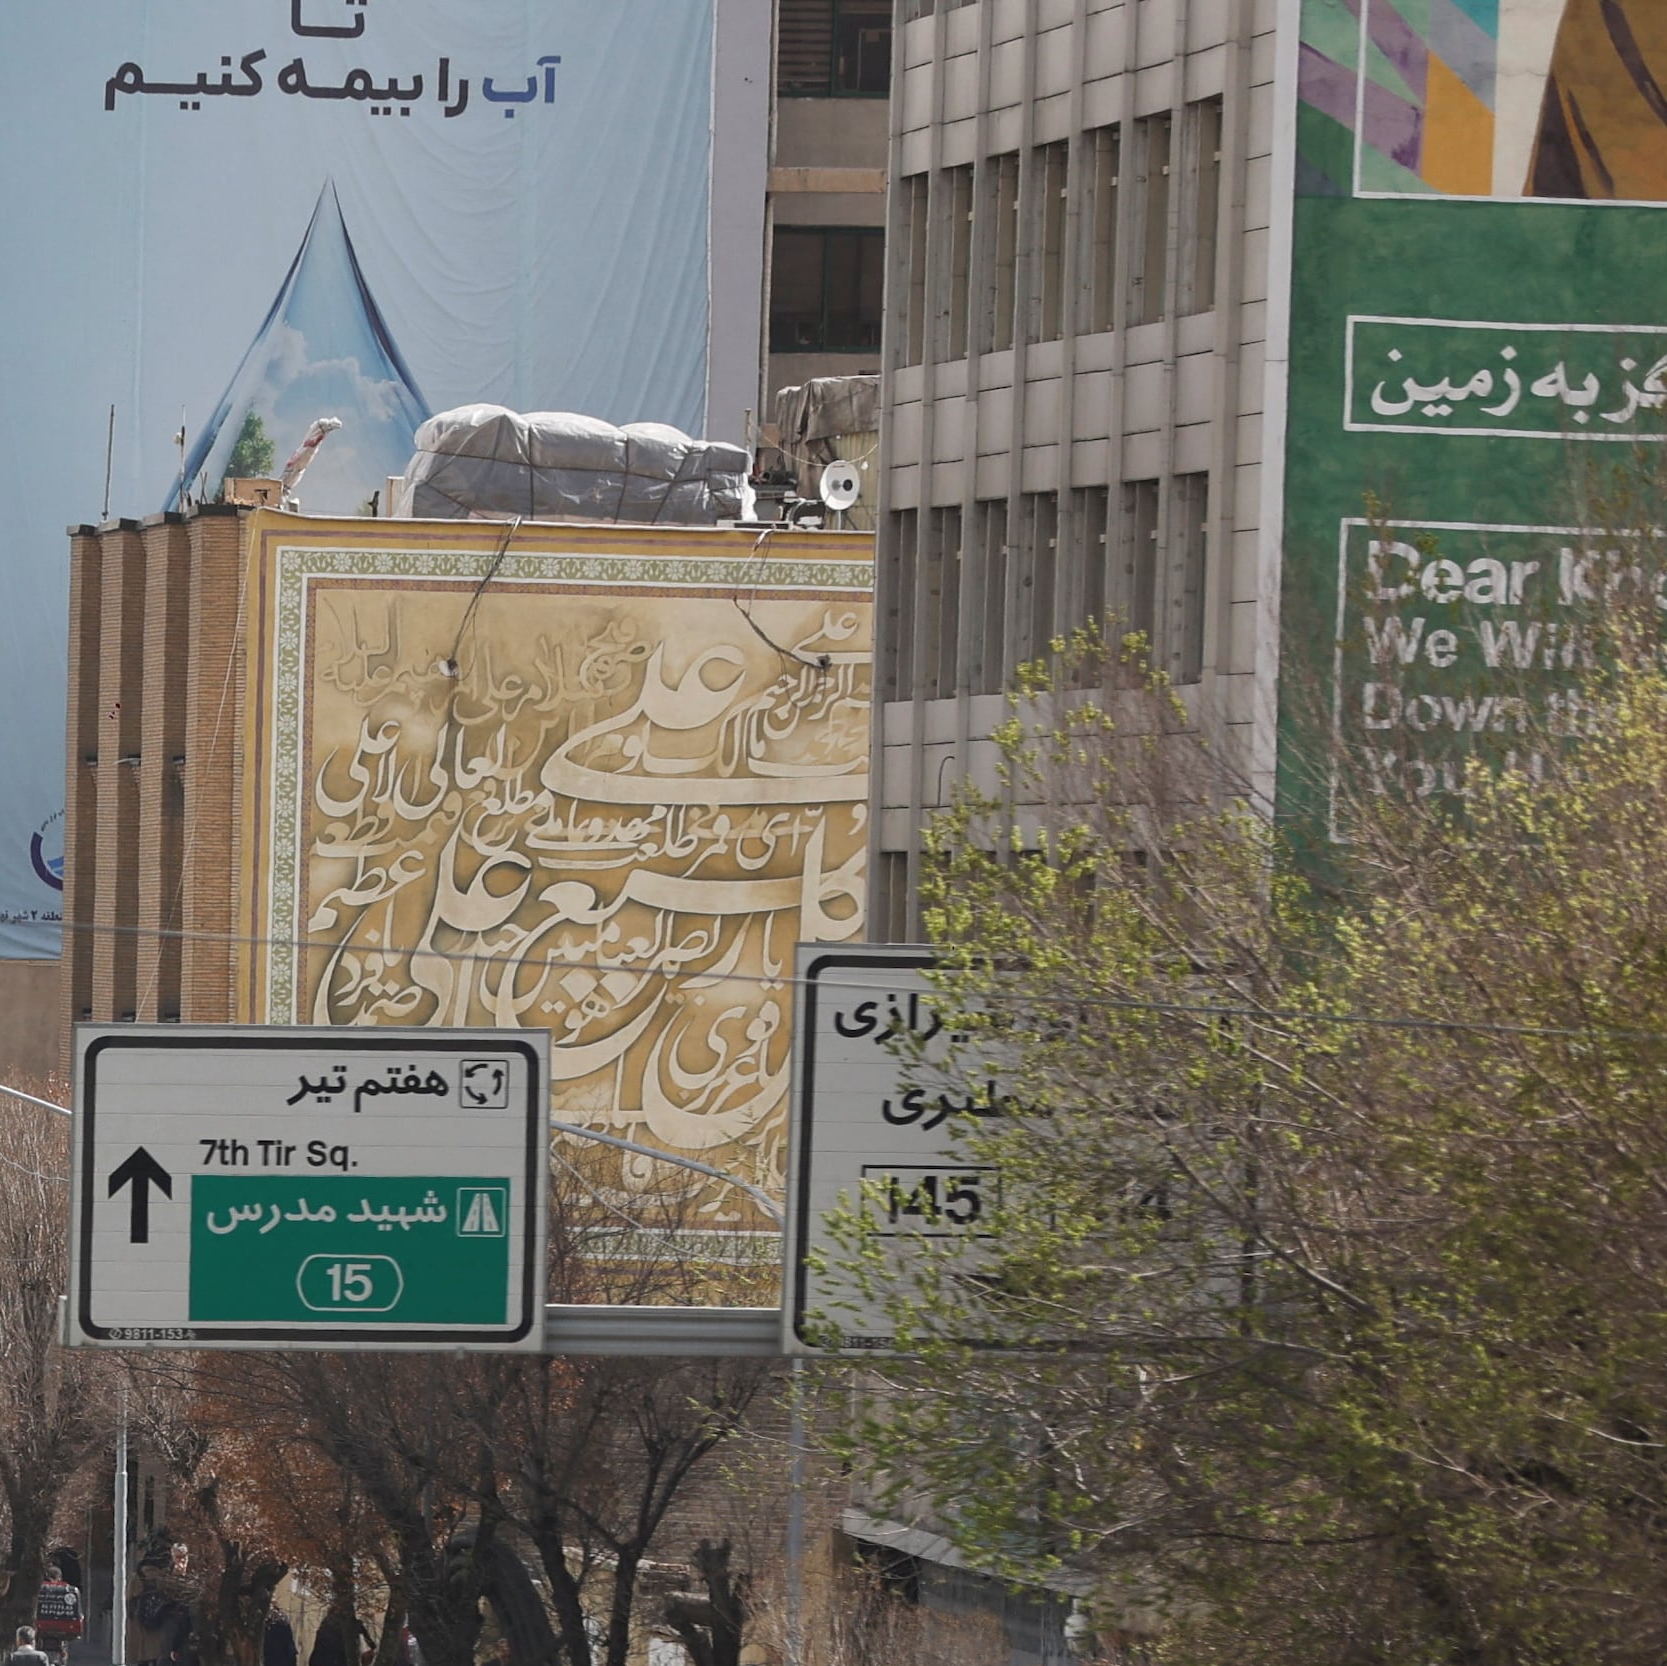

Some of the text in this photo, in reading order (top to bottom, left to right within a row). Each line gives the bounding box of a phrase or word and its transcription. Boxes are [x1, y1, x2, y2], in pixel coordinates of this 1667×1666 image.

[105, 48, 561, 118] آب را بیمه کنیم
[1370, 345, 1520, 418] زمین
[1530, 361, 1601, 425] به
[1367, 540, 1540, 605] Dear
[1364, 617, 1458, 668] We
[1363, 682, 1528, 733] Down
[287, 1064, 449, 1112] هفتم تیر
[200, 1140, 358, 1171] 7th Tir Sq.
[207, 1190, 448, 1234] شهید مدرس
[326, 1263, 373, 1302] 15
